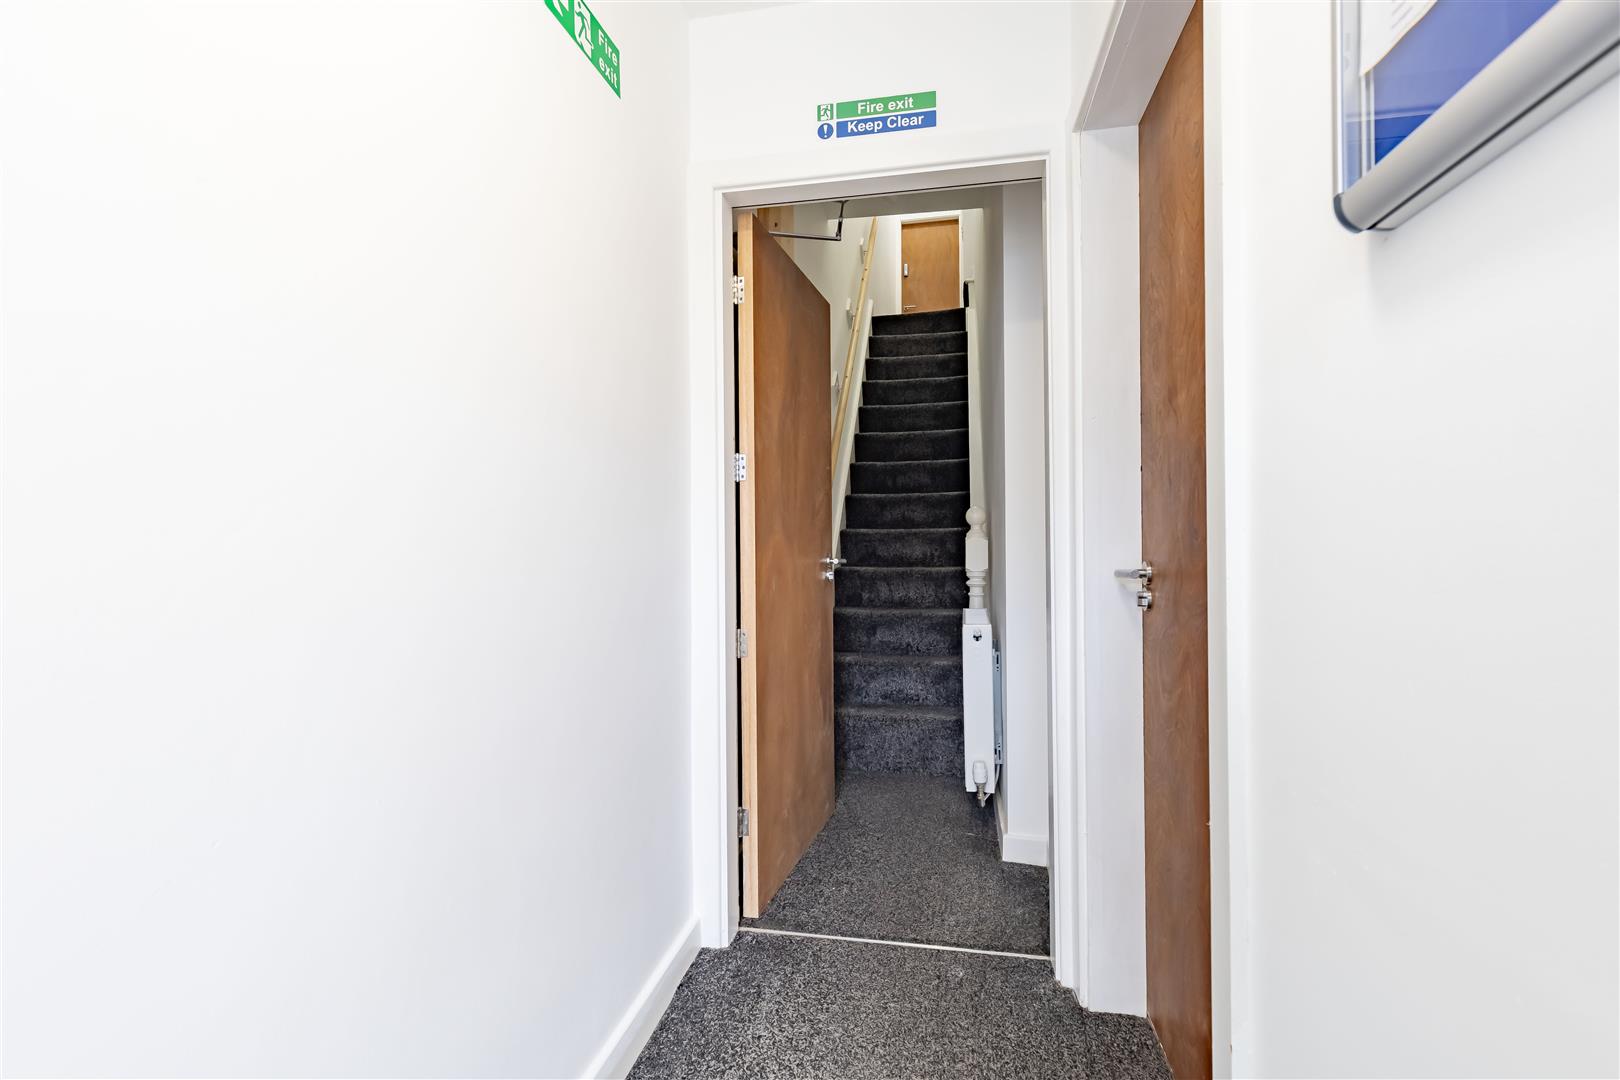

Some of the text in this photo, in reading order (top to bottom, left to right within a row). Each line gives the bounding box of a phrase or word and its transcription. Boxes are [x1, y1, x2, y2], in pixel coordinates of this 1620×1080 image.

[598, 29, 618, 66] Fire
[599, 57, 618, 89] exit
[857, 97, 914, 114] Fire exit
[847, 115, 924, 133] Keep Clear
